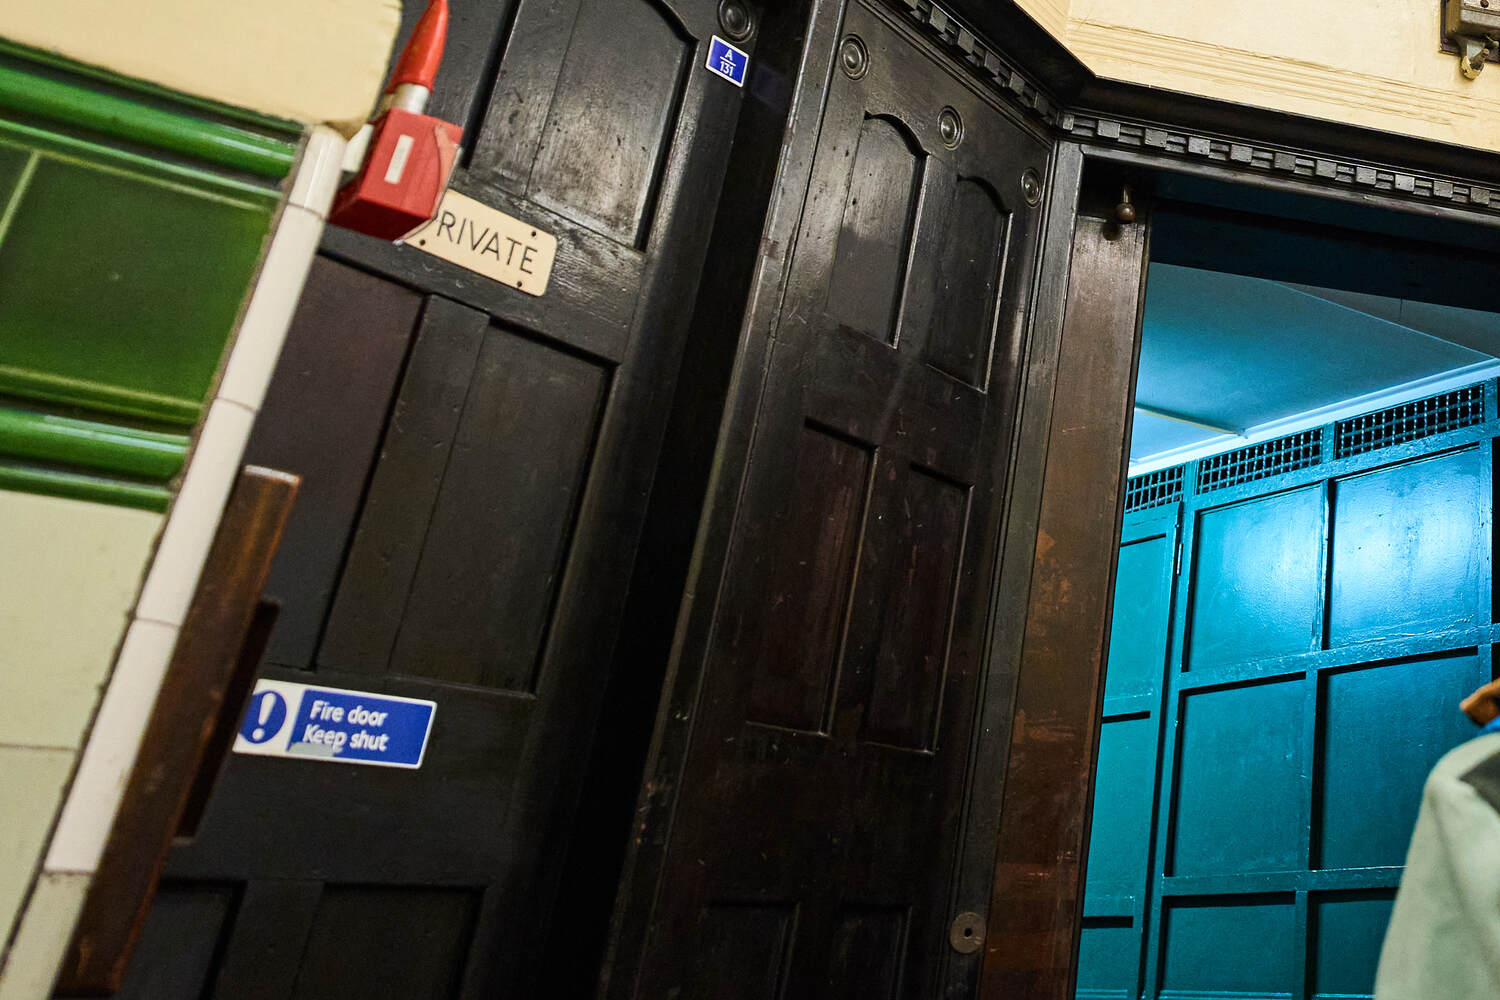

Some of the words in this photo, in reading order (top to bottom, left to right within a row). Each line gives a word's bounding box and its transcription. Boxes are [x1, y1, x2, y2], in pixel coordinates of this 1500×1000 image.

[724, 49, 734, 61] A
[720, 61, 734, 77] 131
[432, 211, 538, 275] RIVATE
[309, 700, 345, 723] Fire
[347, 705, 388, 727] door
[302, 724, 347, 754] Keep
[349, 729, 390, 752] shut
